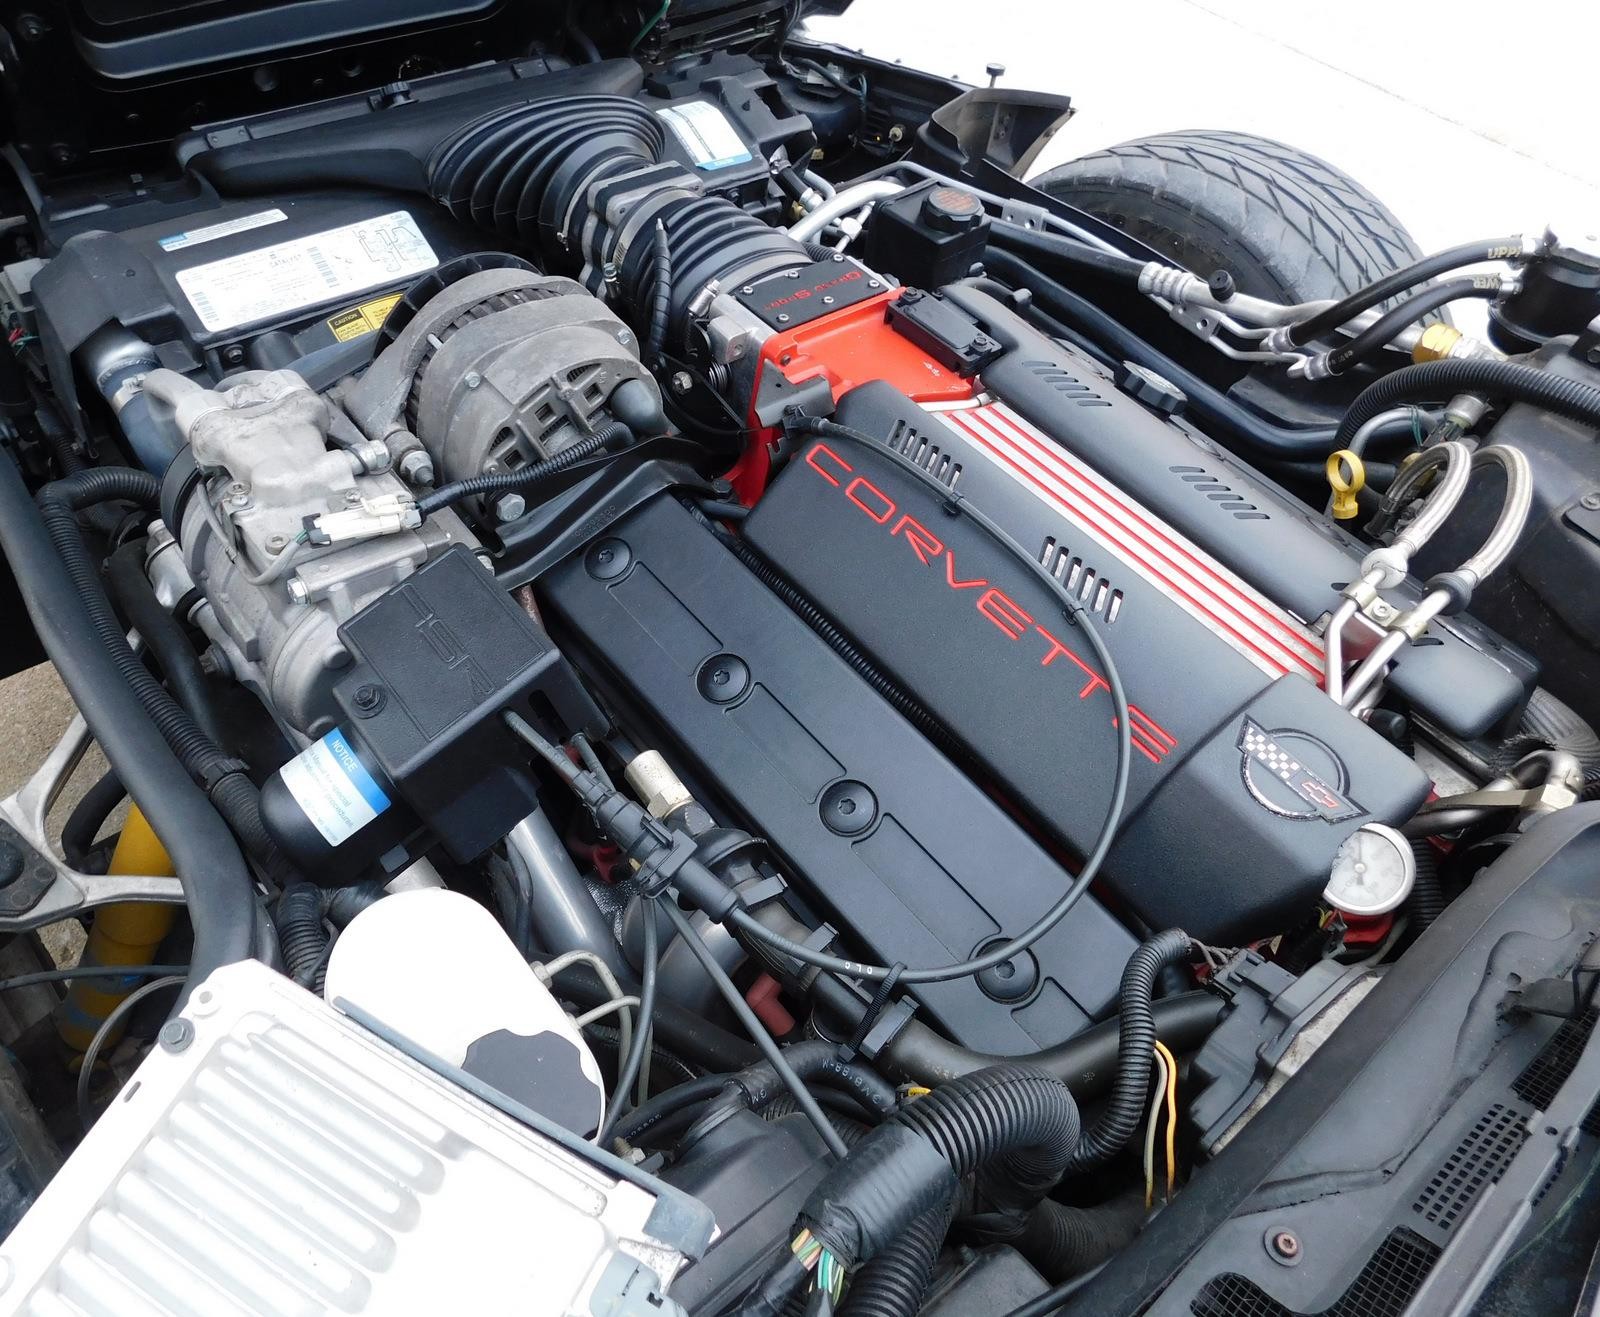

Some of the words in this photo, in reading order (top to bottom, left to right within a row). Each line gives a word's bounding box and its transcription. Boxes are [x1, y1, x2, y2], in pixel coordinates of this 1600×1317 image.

[334, 313, 358, 326] CAUTION
[806, 443, 1177, 764] CORVETTE
[331, 740, 358, 772] NOTICE
